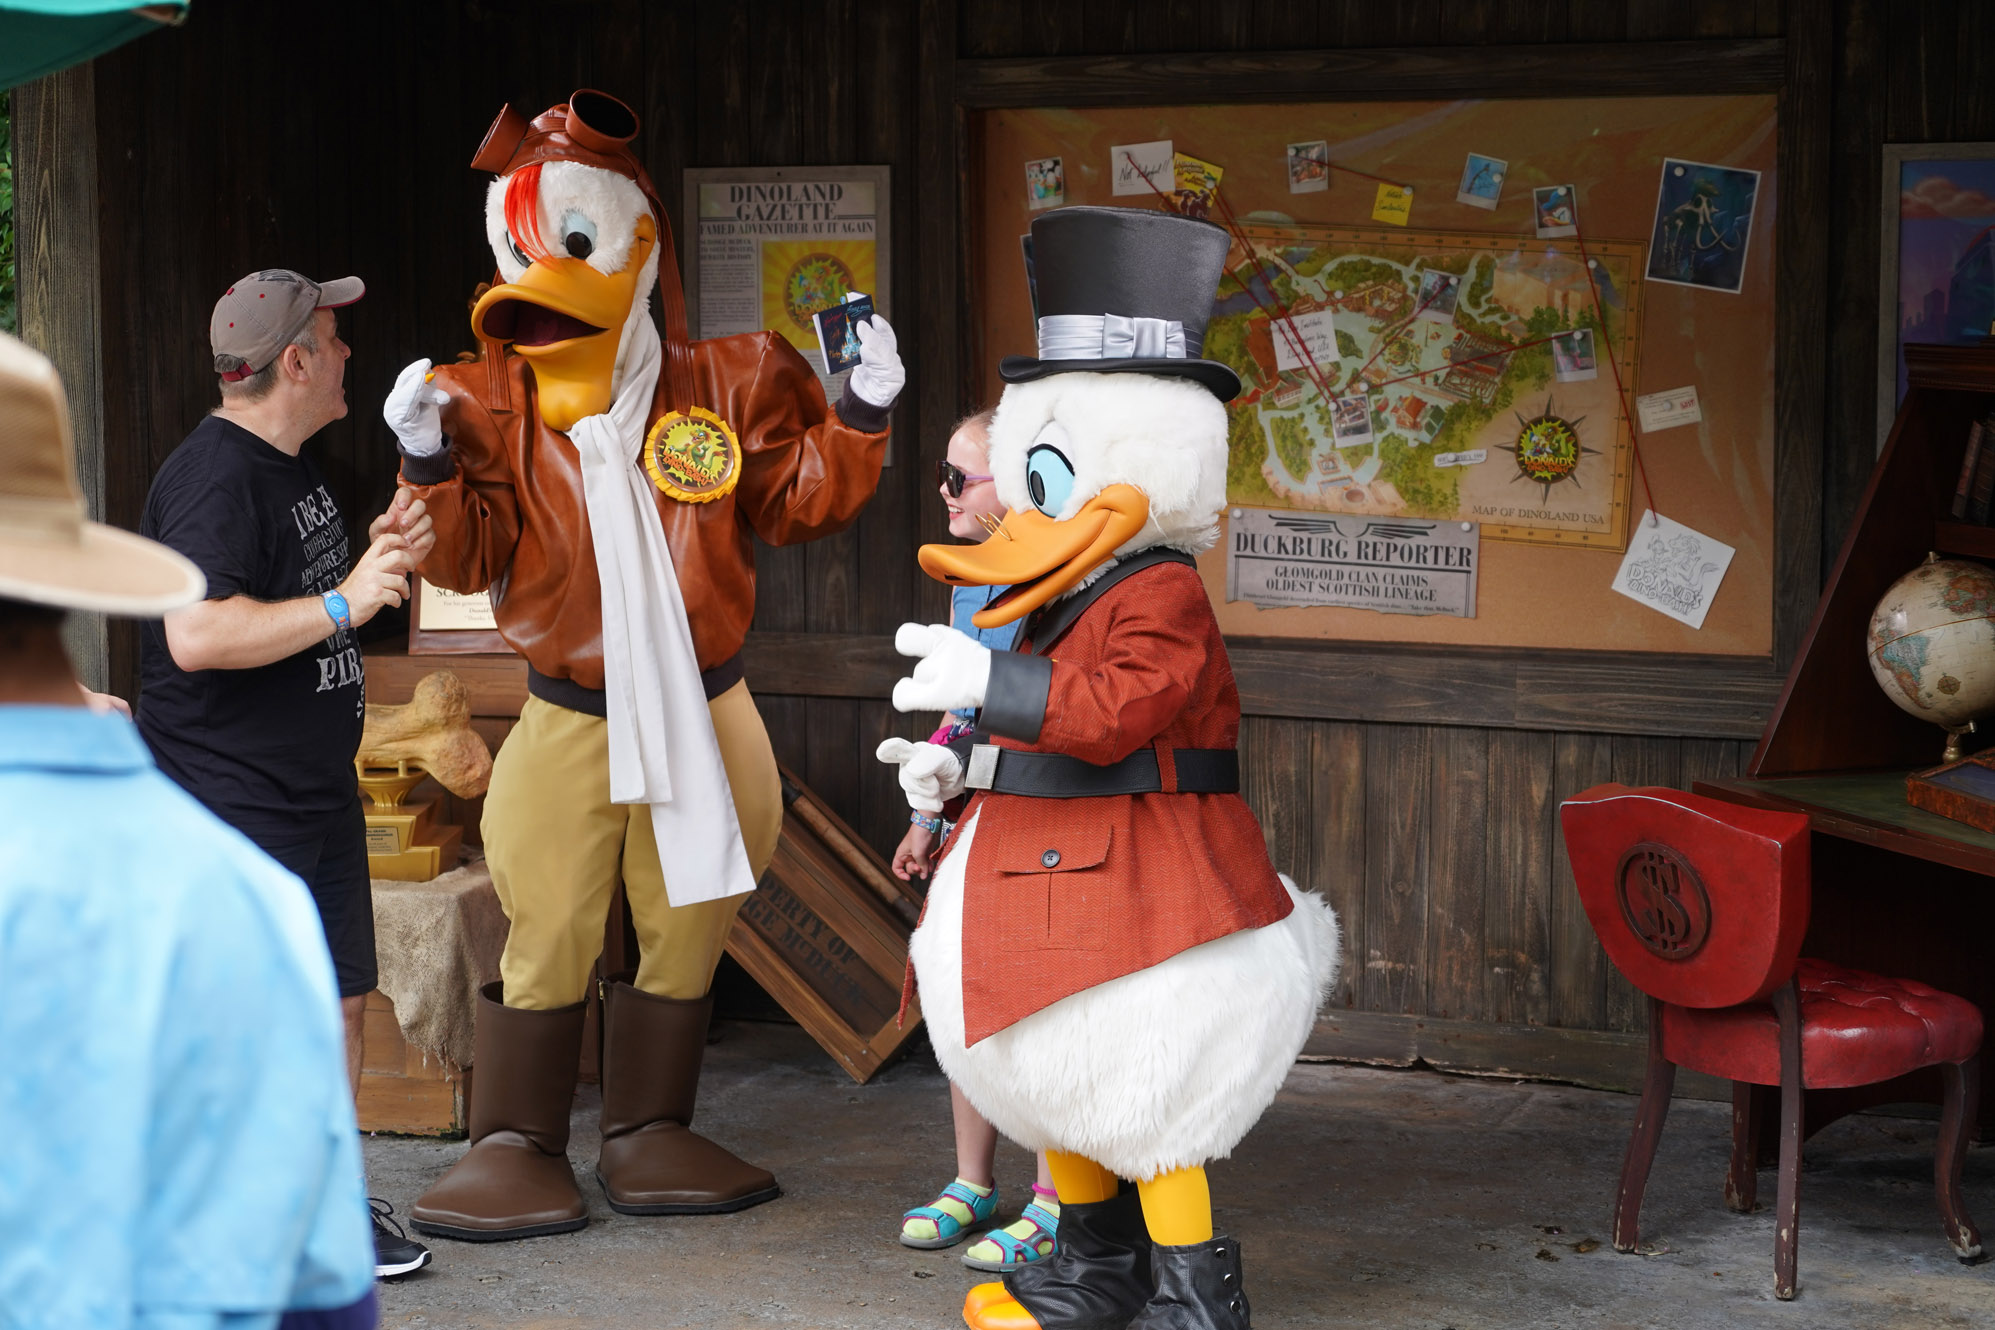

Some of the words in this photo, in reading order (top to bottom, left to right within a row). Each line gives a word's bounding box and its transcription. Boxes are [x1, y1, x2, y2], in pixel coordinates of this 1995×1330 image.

[730, 183, 843, 203] DINOLAND
[736, 202, 837, 222] GAZETTE
[700, 223, 735, 235] FAMED
[736, 222, 808, 235] ADVENTURER
[811, 222, 824, 234] AT
[827, 222, 838, 233] IT
[840, 221, 874, 233] AGAIN
[662, 444, 717, 486] DONALD'S
[1524, 454, 1576, 467] DONALD'S
[1472, 505, 1497, 516] MAP
[1500, 505, 1515, 517] OF
[1518, 508, 1580, 522] DINOLAND
[1583, 513, 1605, 525] USA
[1236, 532, 1349, 560] DUCKBURG
[1356, 539, 1472, 568] REPORTER
[1274, 565, 1344, 582] GLOMGOLD
[1348, 570, 1379, 584] CLAN
[1383, 572, 1429, 588] CLAIMS
[1626, 563, 1704, 611] DONALD'S
[1266, 577, 1316, 593] OLDEST
[1318, 581, 1380, 599] SCOTTISH
[1383, 586, 1438, 602] LINEAGE
[316, 647, 364, 693] PIR
[826, 936, 860, 965] OF
